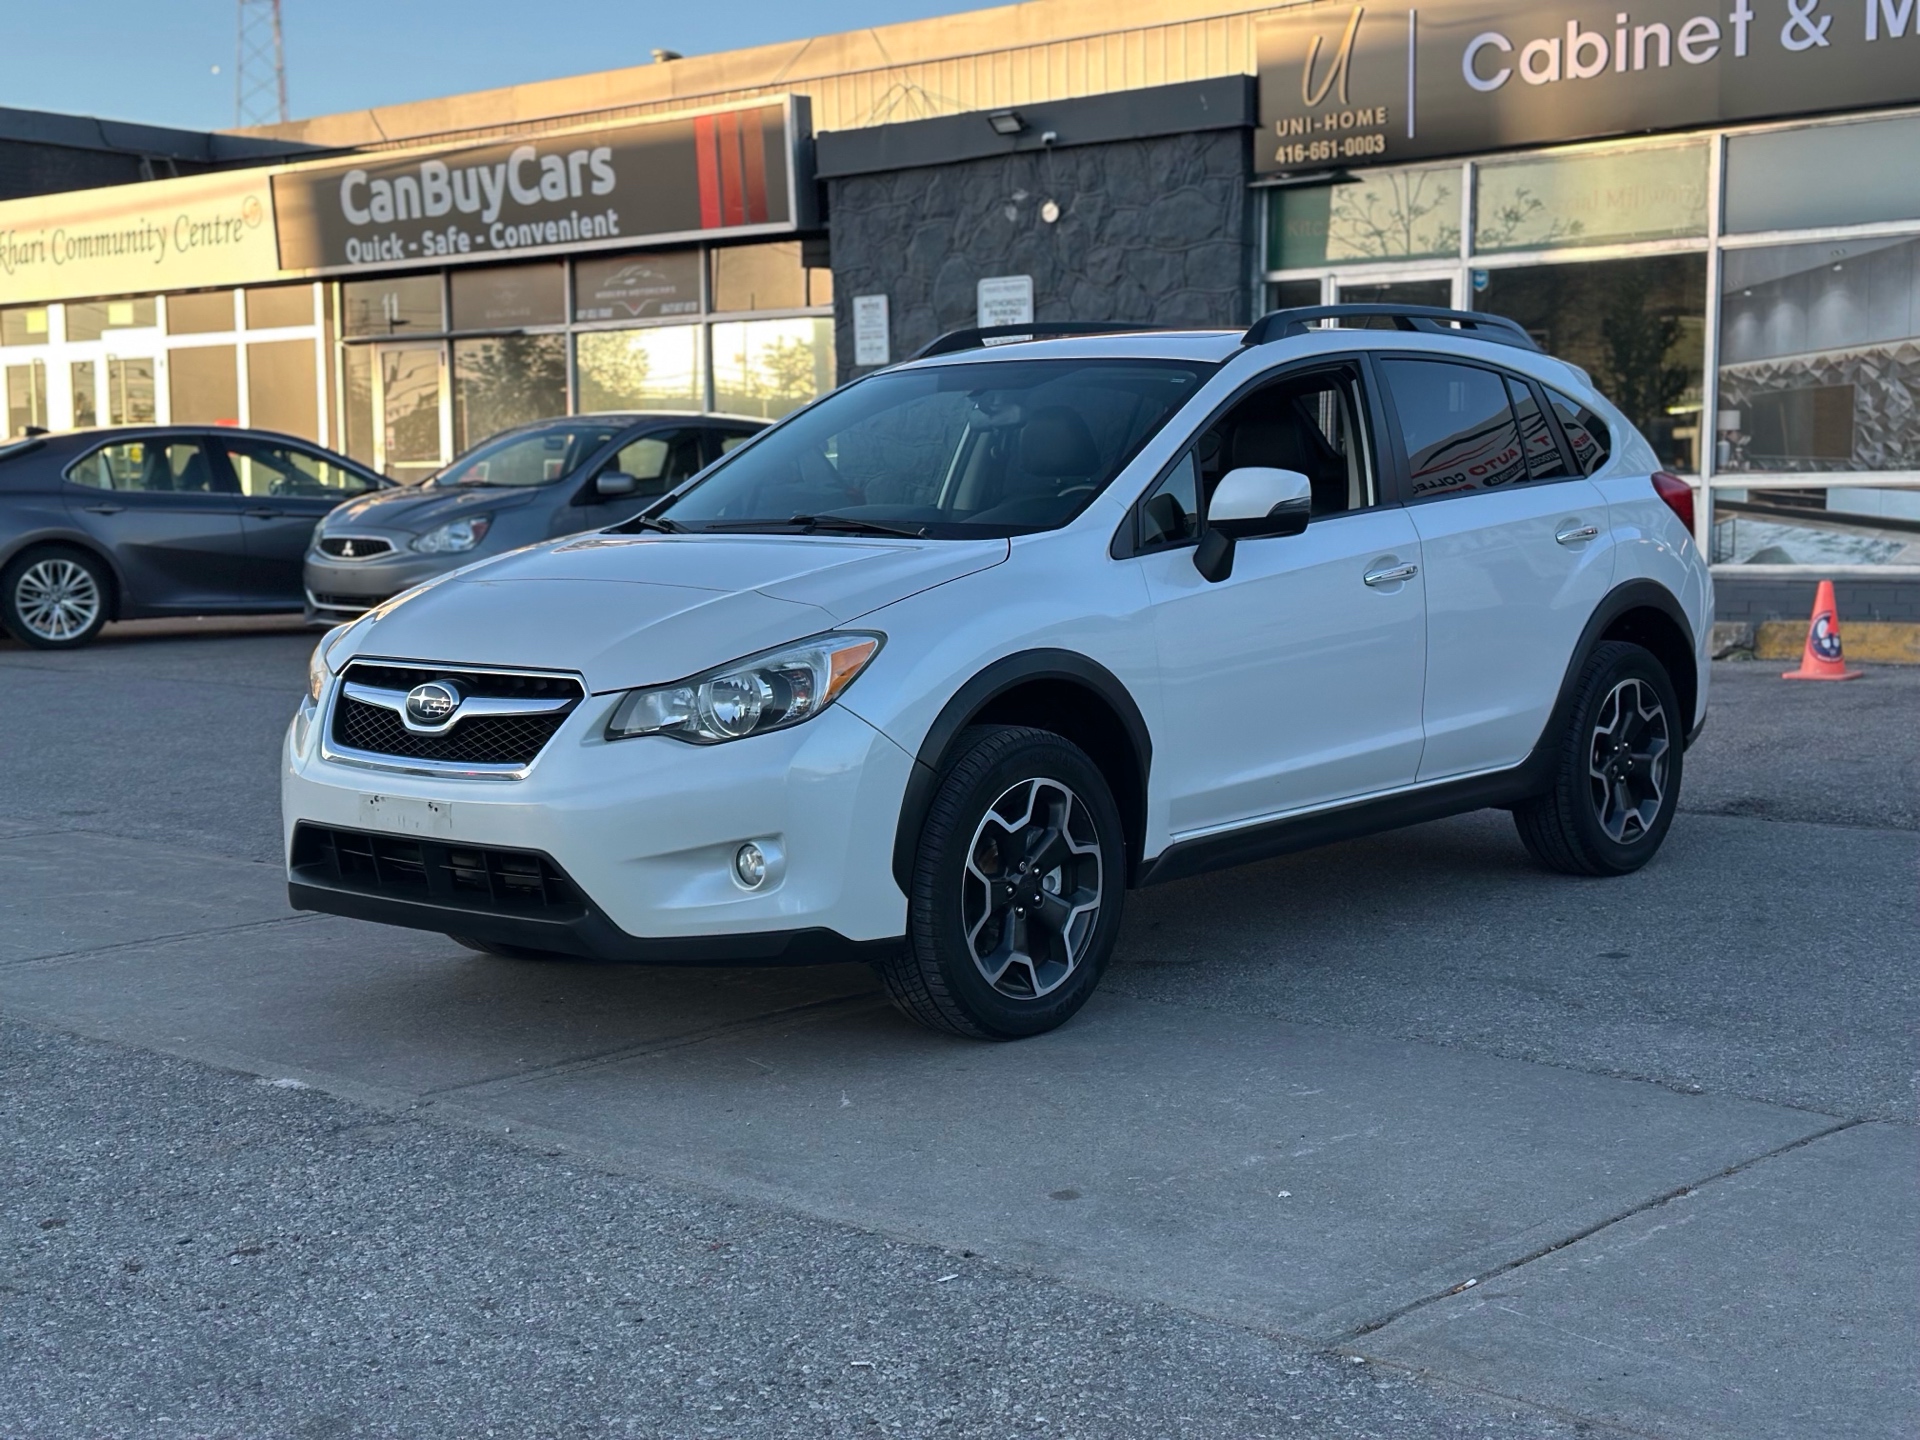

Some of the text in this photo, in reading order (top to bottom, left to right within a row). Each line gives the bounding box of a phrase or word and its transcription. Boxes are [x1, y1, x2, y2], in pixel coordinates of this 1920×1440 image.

[1462, 0, 1754, 92] Cabinet
[1780, 0, 1832, 51] &
[1275, 106, 1387, 137] UNI-HOME
[1275, 133, 1386, 165] 416-661-0003
[340, 145, 616, 226] CanBuyCars
[52, 217, 167, 265] Community
[174, 213, 243, 254] Centre
[345, 231, 404, 264] Quick
[422, 226, 471, 257] Safe
[489, 208, 620, 250] Convenient
[381, 291, 399, 321] 11
